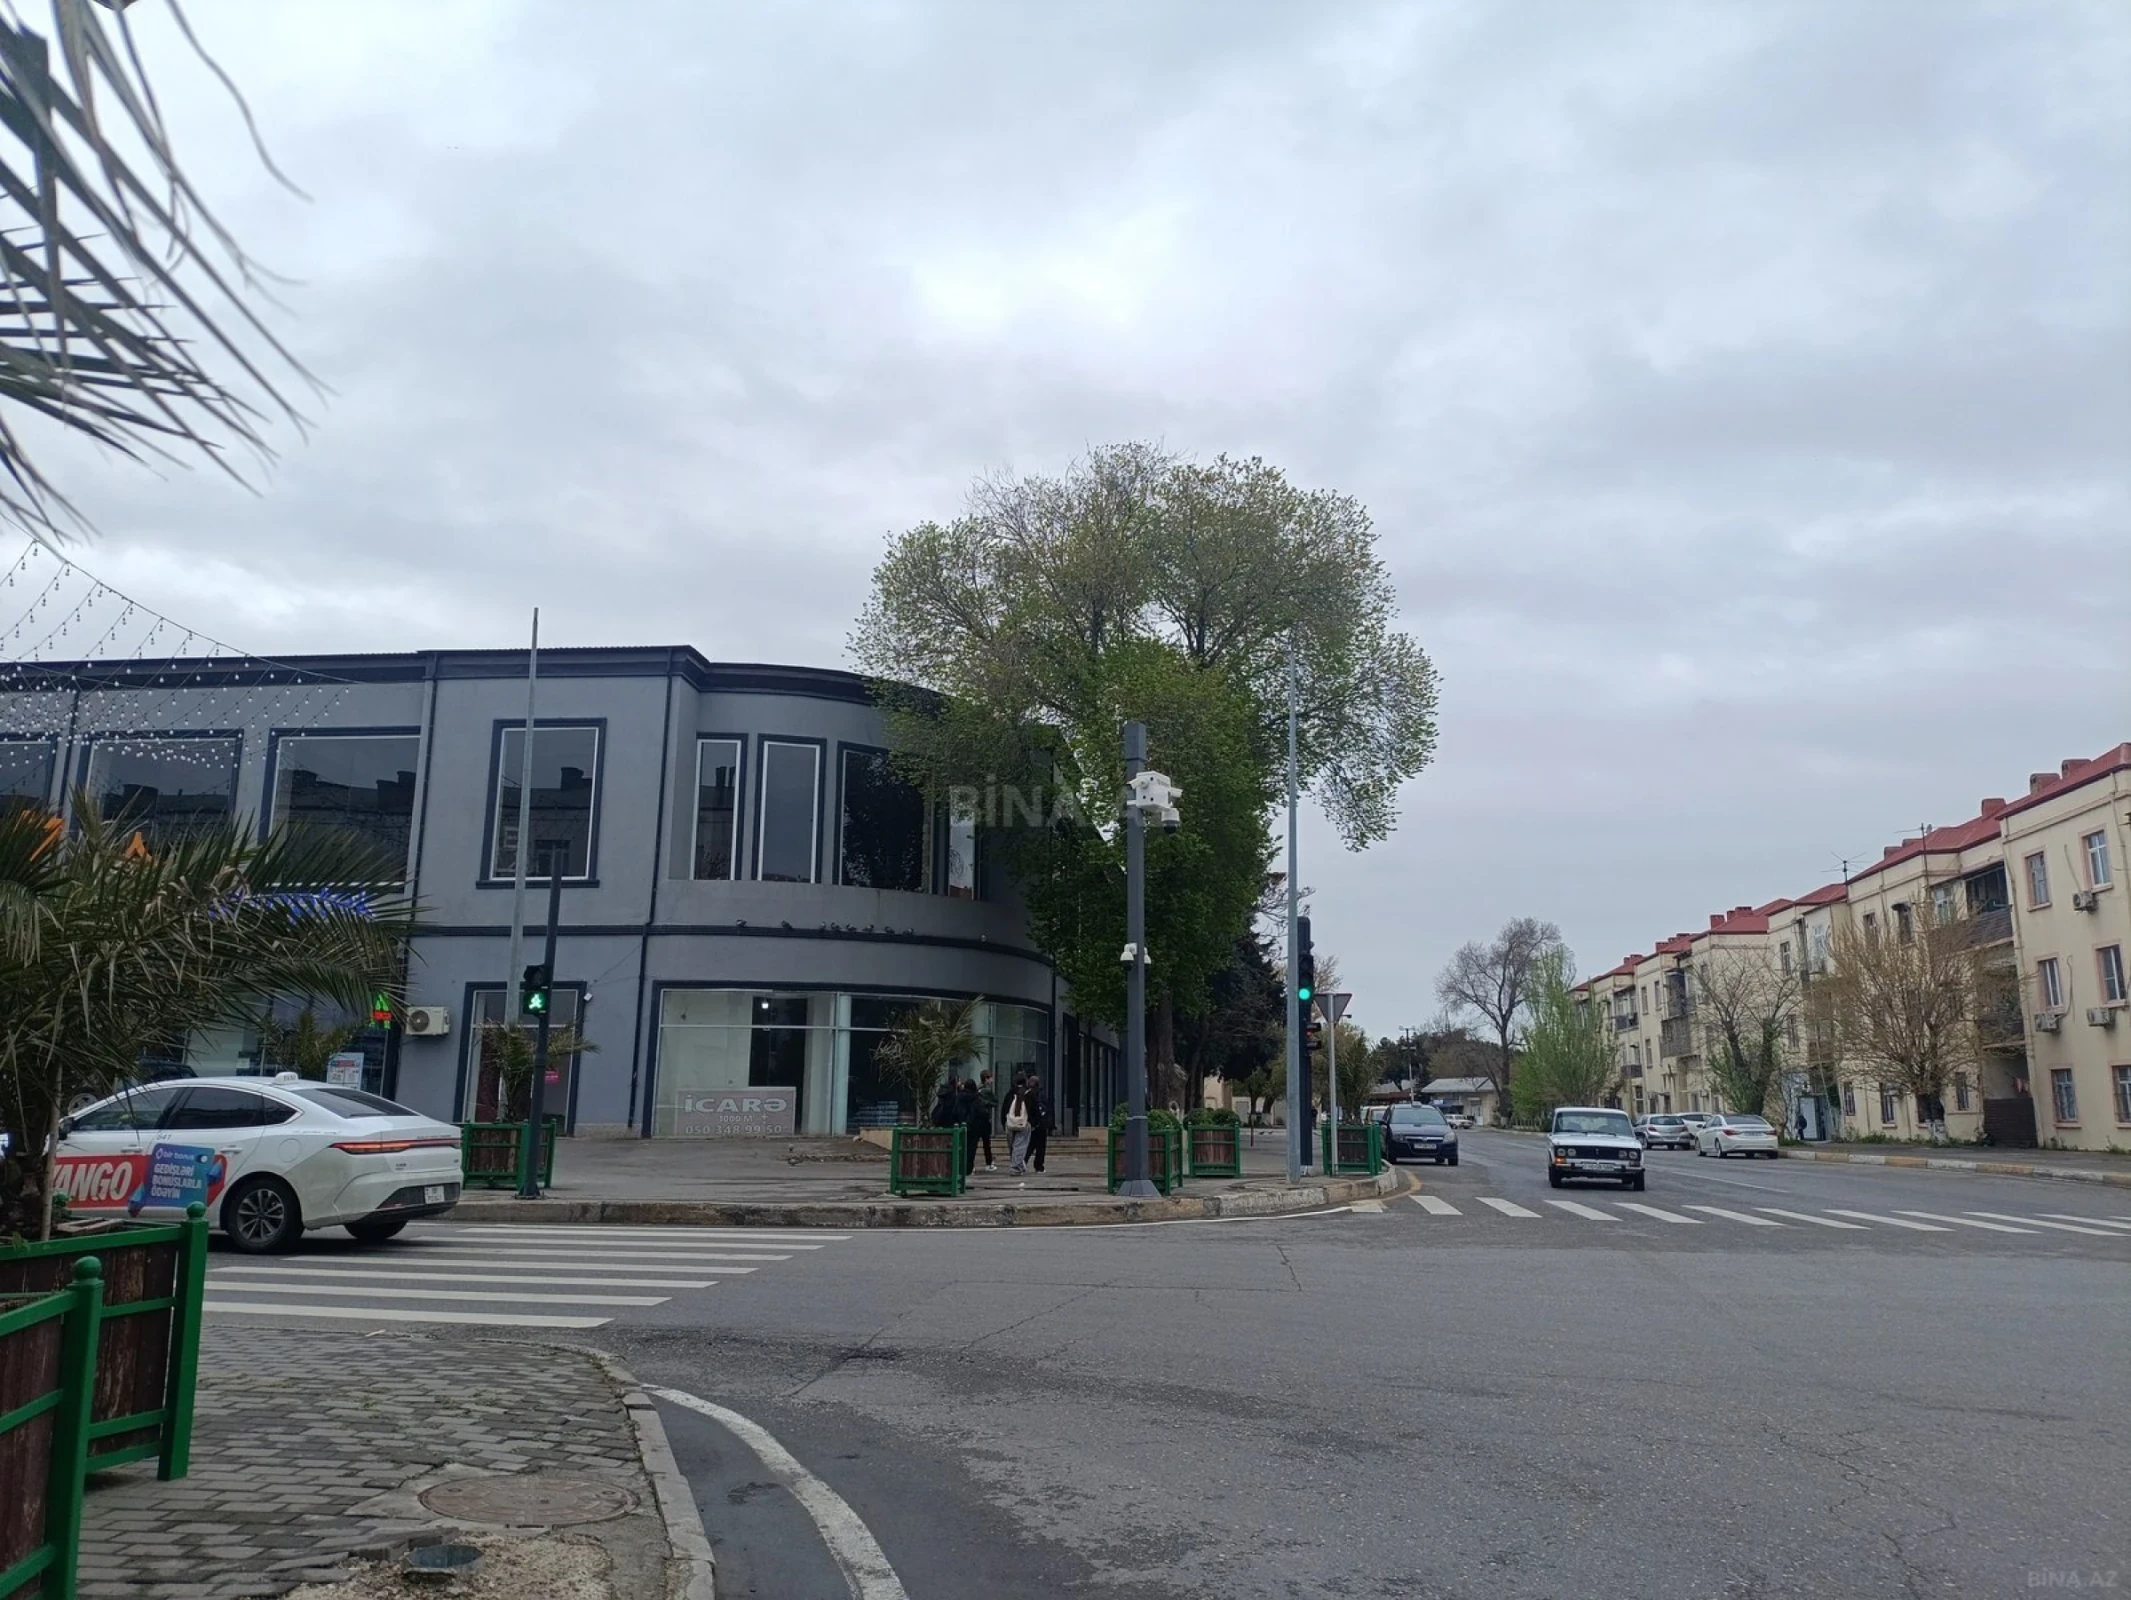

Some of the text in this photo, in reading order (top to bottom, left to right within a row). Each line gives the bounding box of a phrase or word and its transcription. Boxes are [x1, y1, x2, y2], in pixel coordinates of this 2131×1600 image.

[685, 1125, 783, 1134] 050 348 99 50
